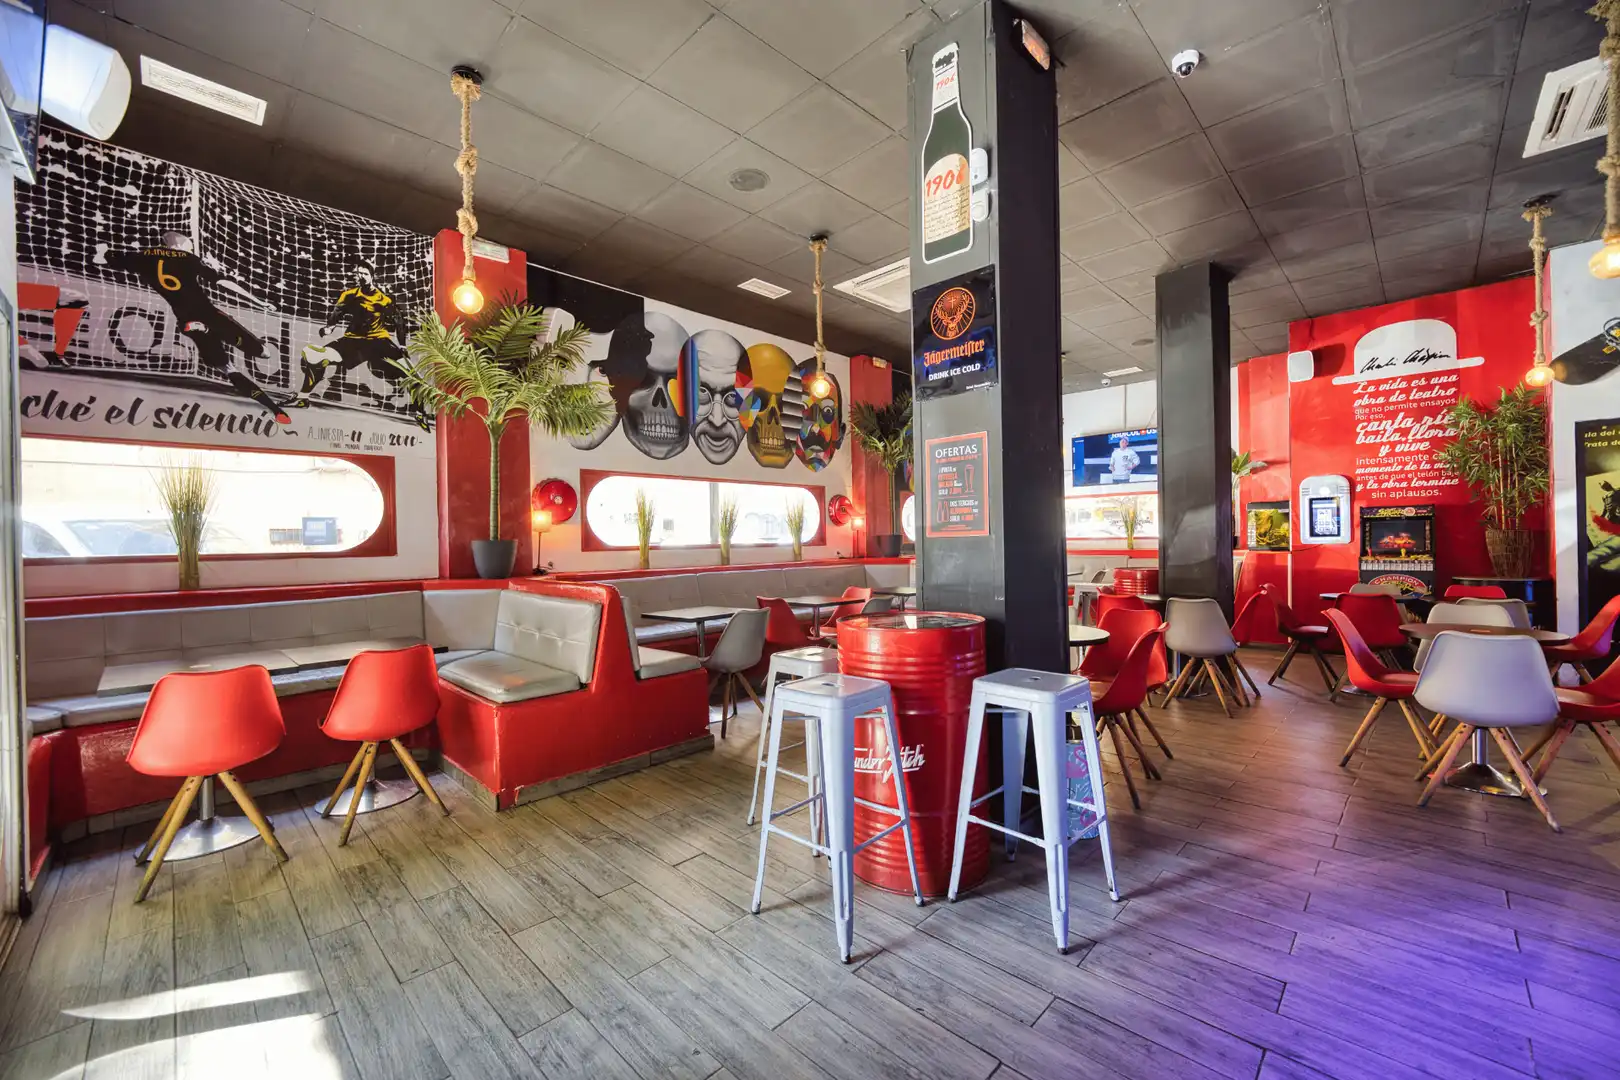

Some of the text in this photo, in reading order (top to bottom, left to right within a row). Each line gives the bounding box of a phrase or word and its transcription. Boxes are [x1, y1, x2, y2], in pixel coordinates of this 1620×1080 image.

[936, 72, 956, 91] 1906
[926, 164, 966, 197] 1906
[158, 260, 181, 291] 6
[929, 363, 981, 381] DRINK ICE COLD
[1353, 374, 1459, 394] La vida es una
[1353, 386, 1457, 407] obra de teatro
[1354, 407, 1370, 415] que
[1384, 402, 1418, 412] permite
[1420, 398, 1458, 408] ensayos.
[104, 397, 149, 426] el
[153, 402, 279, 438] silencio
[351, 430, 362, 442] 11
[935, 444, 978, 459] OFERTAS
[1379, 440, 1431, 456] y vive
[1356, 453, 1429, 465] intensamente
[1355, 463, 1402, 474] momento
[1404, 462, 1418, 470] de
[1420, 461, 1432, 470] tu
[1391, 473, 1406, 481] que
[1417, 470, 1439, 478] telón
[1356, 477, 1459, 492] y la obra termine
[1372, 489, 1442, 499] sin aplausos.
[1375, 576, 1419, 586] CHAMPION
